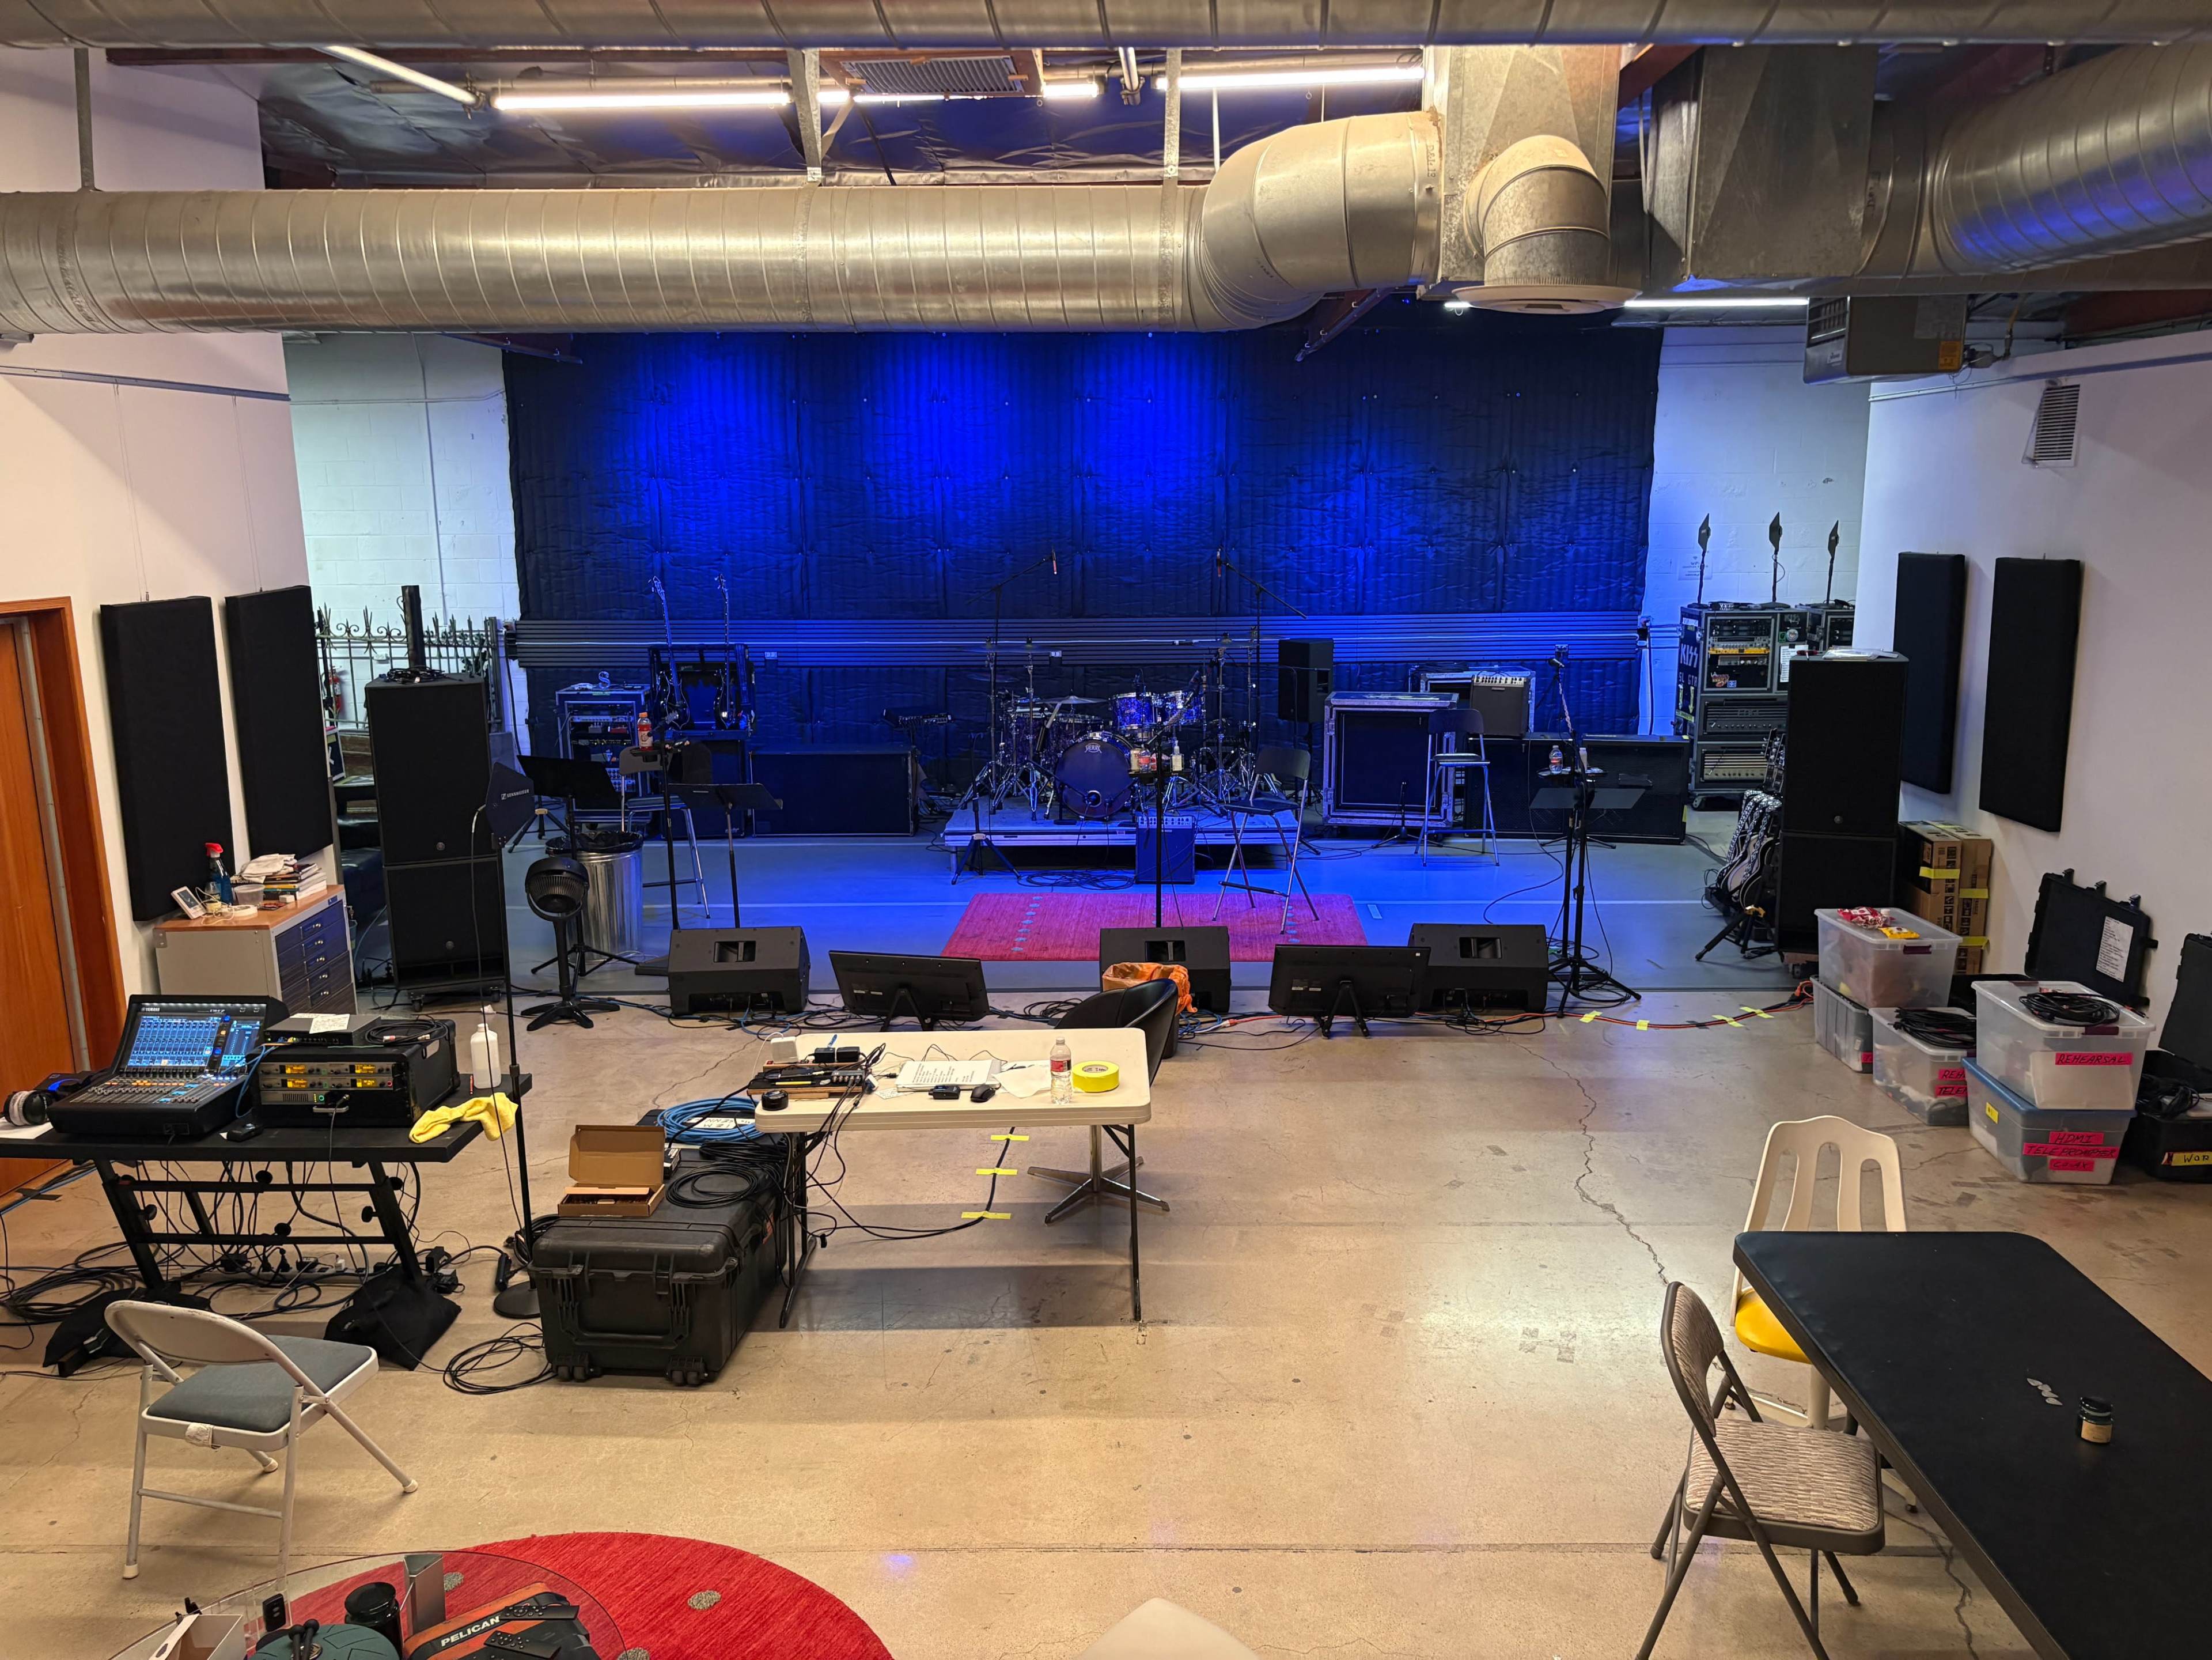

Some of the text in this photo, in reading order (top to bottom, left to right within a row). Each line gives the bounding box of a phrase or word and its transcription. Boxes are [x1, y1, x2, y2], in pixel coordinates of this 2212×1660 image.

[1680, 643, 1698, 668] KISS
[1688, 675, 1698, 687] GTR
[507, 789, 529, 798] SENNHEISER
[2057, 1053, 2126, 1065] REHEARSAL
[2055, 1133, 2093, 1144] HDMI
[441, 1616, 500, 1647] PELICAN
